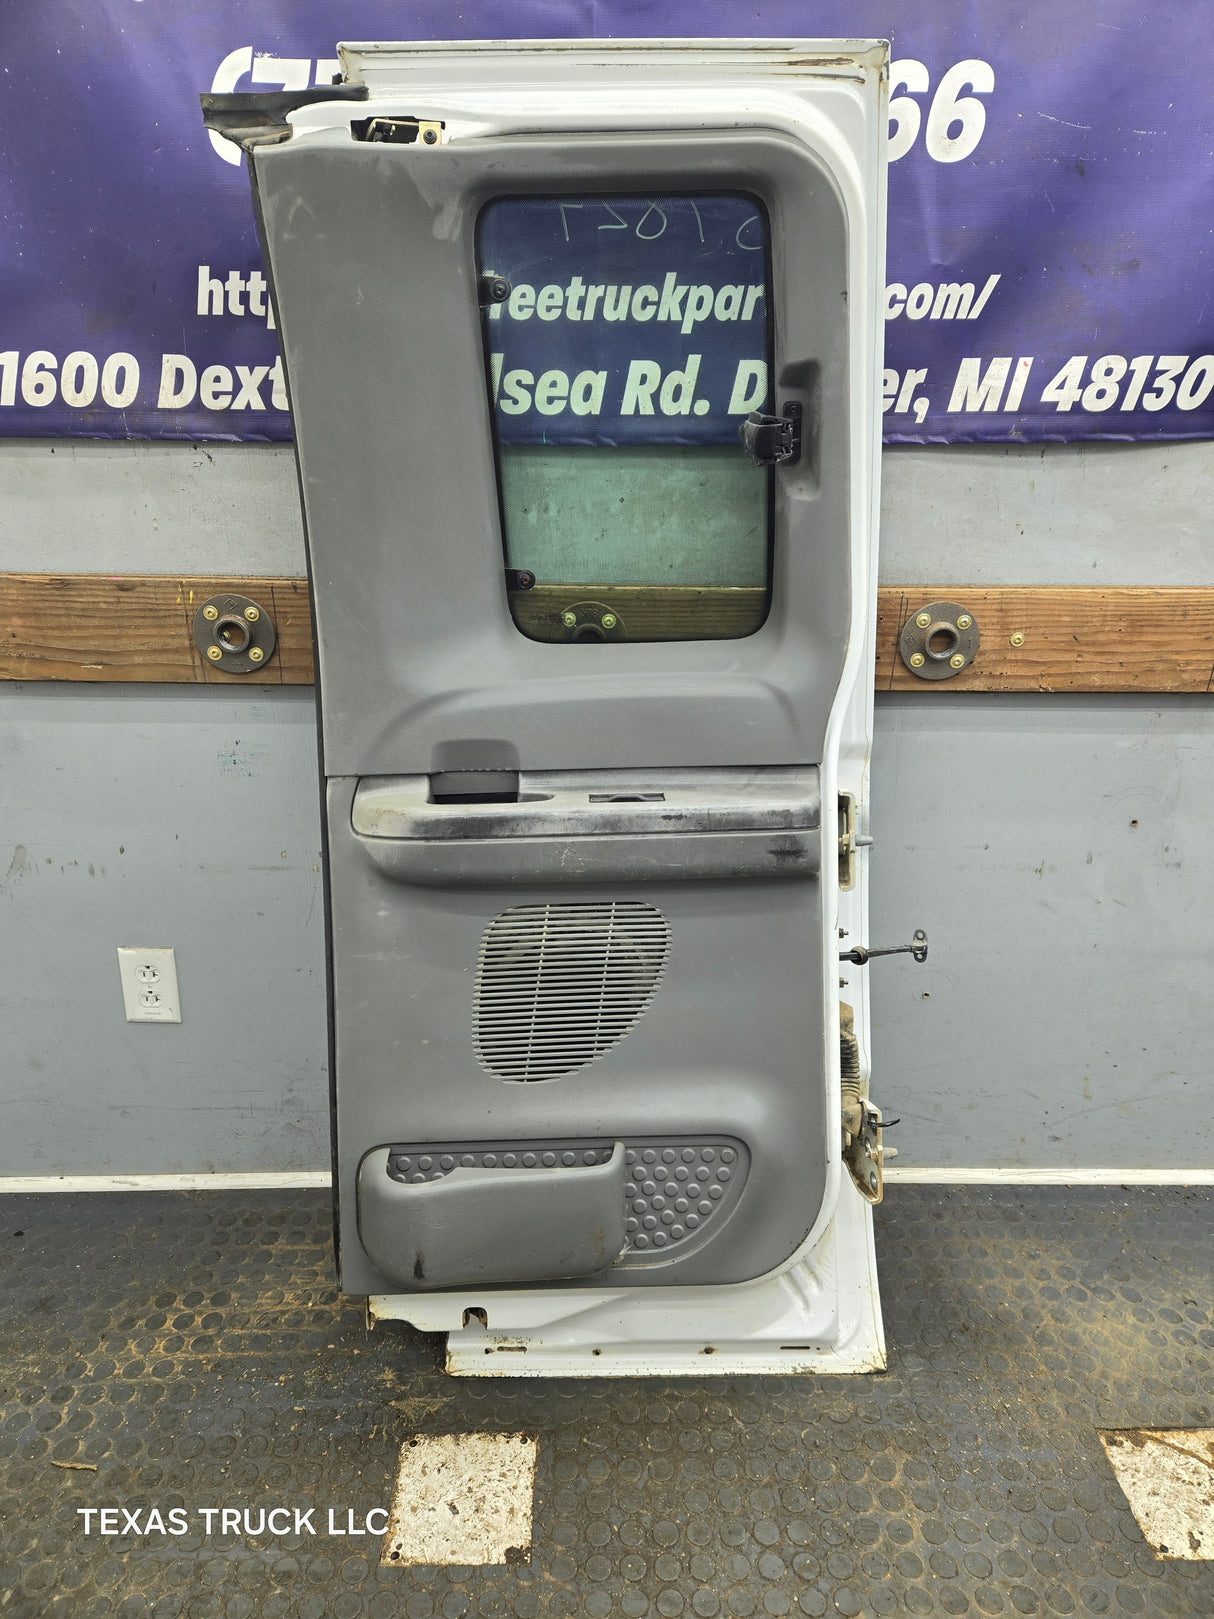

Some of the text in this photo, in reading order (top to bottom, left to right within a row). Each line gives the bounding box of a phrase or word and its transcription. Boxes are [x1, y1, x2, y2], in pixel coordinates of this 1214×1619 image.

[0, 350, 140, 408] 1600
[620, 354, 711, 415] Rd.
[947, 357, 1034, 412] MI
[1040, 354, 1214, 412] 48130
